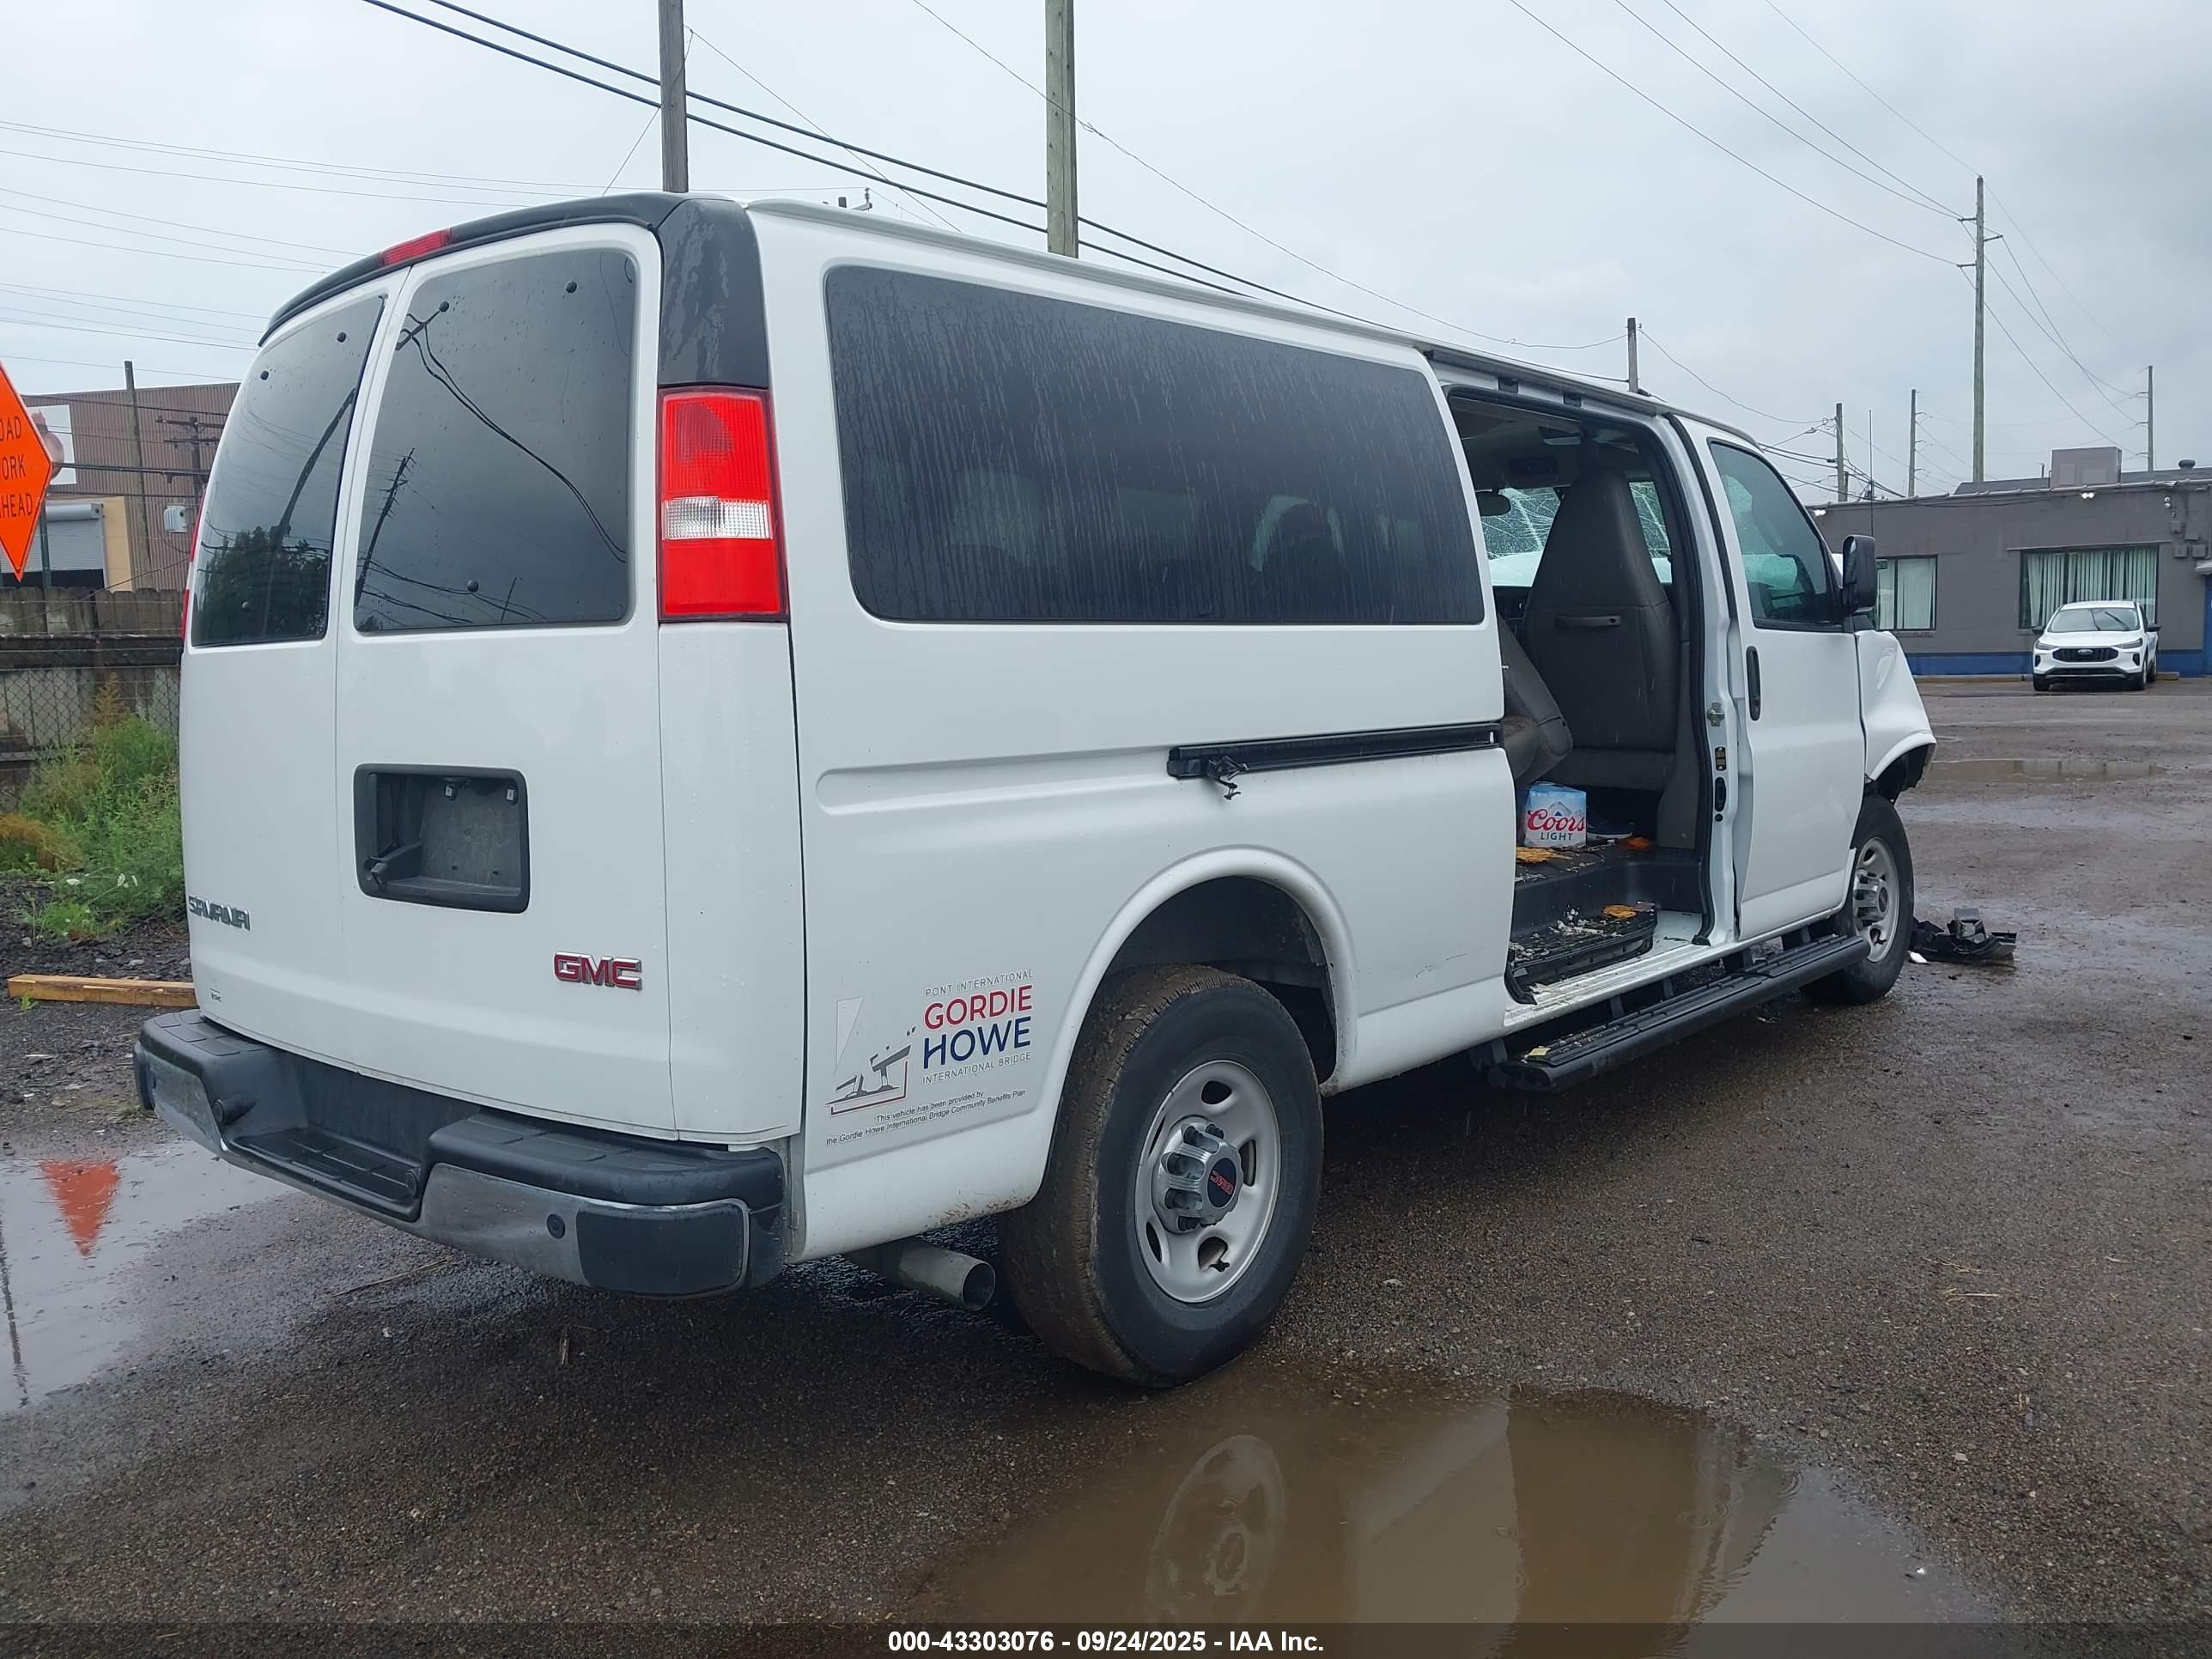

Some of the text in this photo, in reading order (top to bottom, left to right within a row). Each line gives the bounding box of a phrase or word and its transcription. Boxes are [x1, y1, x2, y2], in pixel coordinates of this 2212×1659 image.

[0, 416, 21, 441] OAD
[1, 454, 27, 480] ORK
[0, 493, 33, 518] HEAD
[1528, 809, 1584, 831] Coors
[1540, 832, 1573, 841] LIGHT
[189, 895, 251, 932] SAVANA
[554, 951, 642, 991] GMC
[926, 969, 1033, 997] PONT INTERNATIONAL
[924, 985, 1032, 1030] GORDIE
[923, 1016, 1031, 1069] HOWE
[921, 1052, 1031, 1085] INTERNATIONAL BRIDGE
[826, 1089, 1026, 1146] the Gordie Howe International Bridge Community Benefits Plan
[877, 1091, 984, 1122] This vehicle has been provided by
